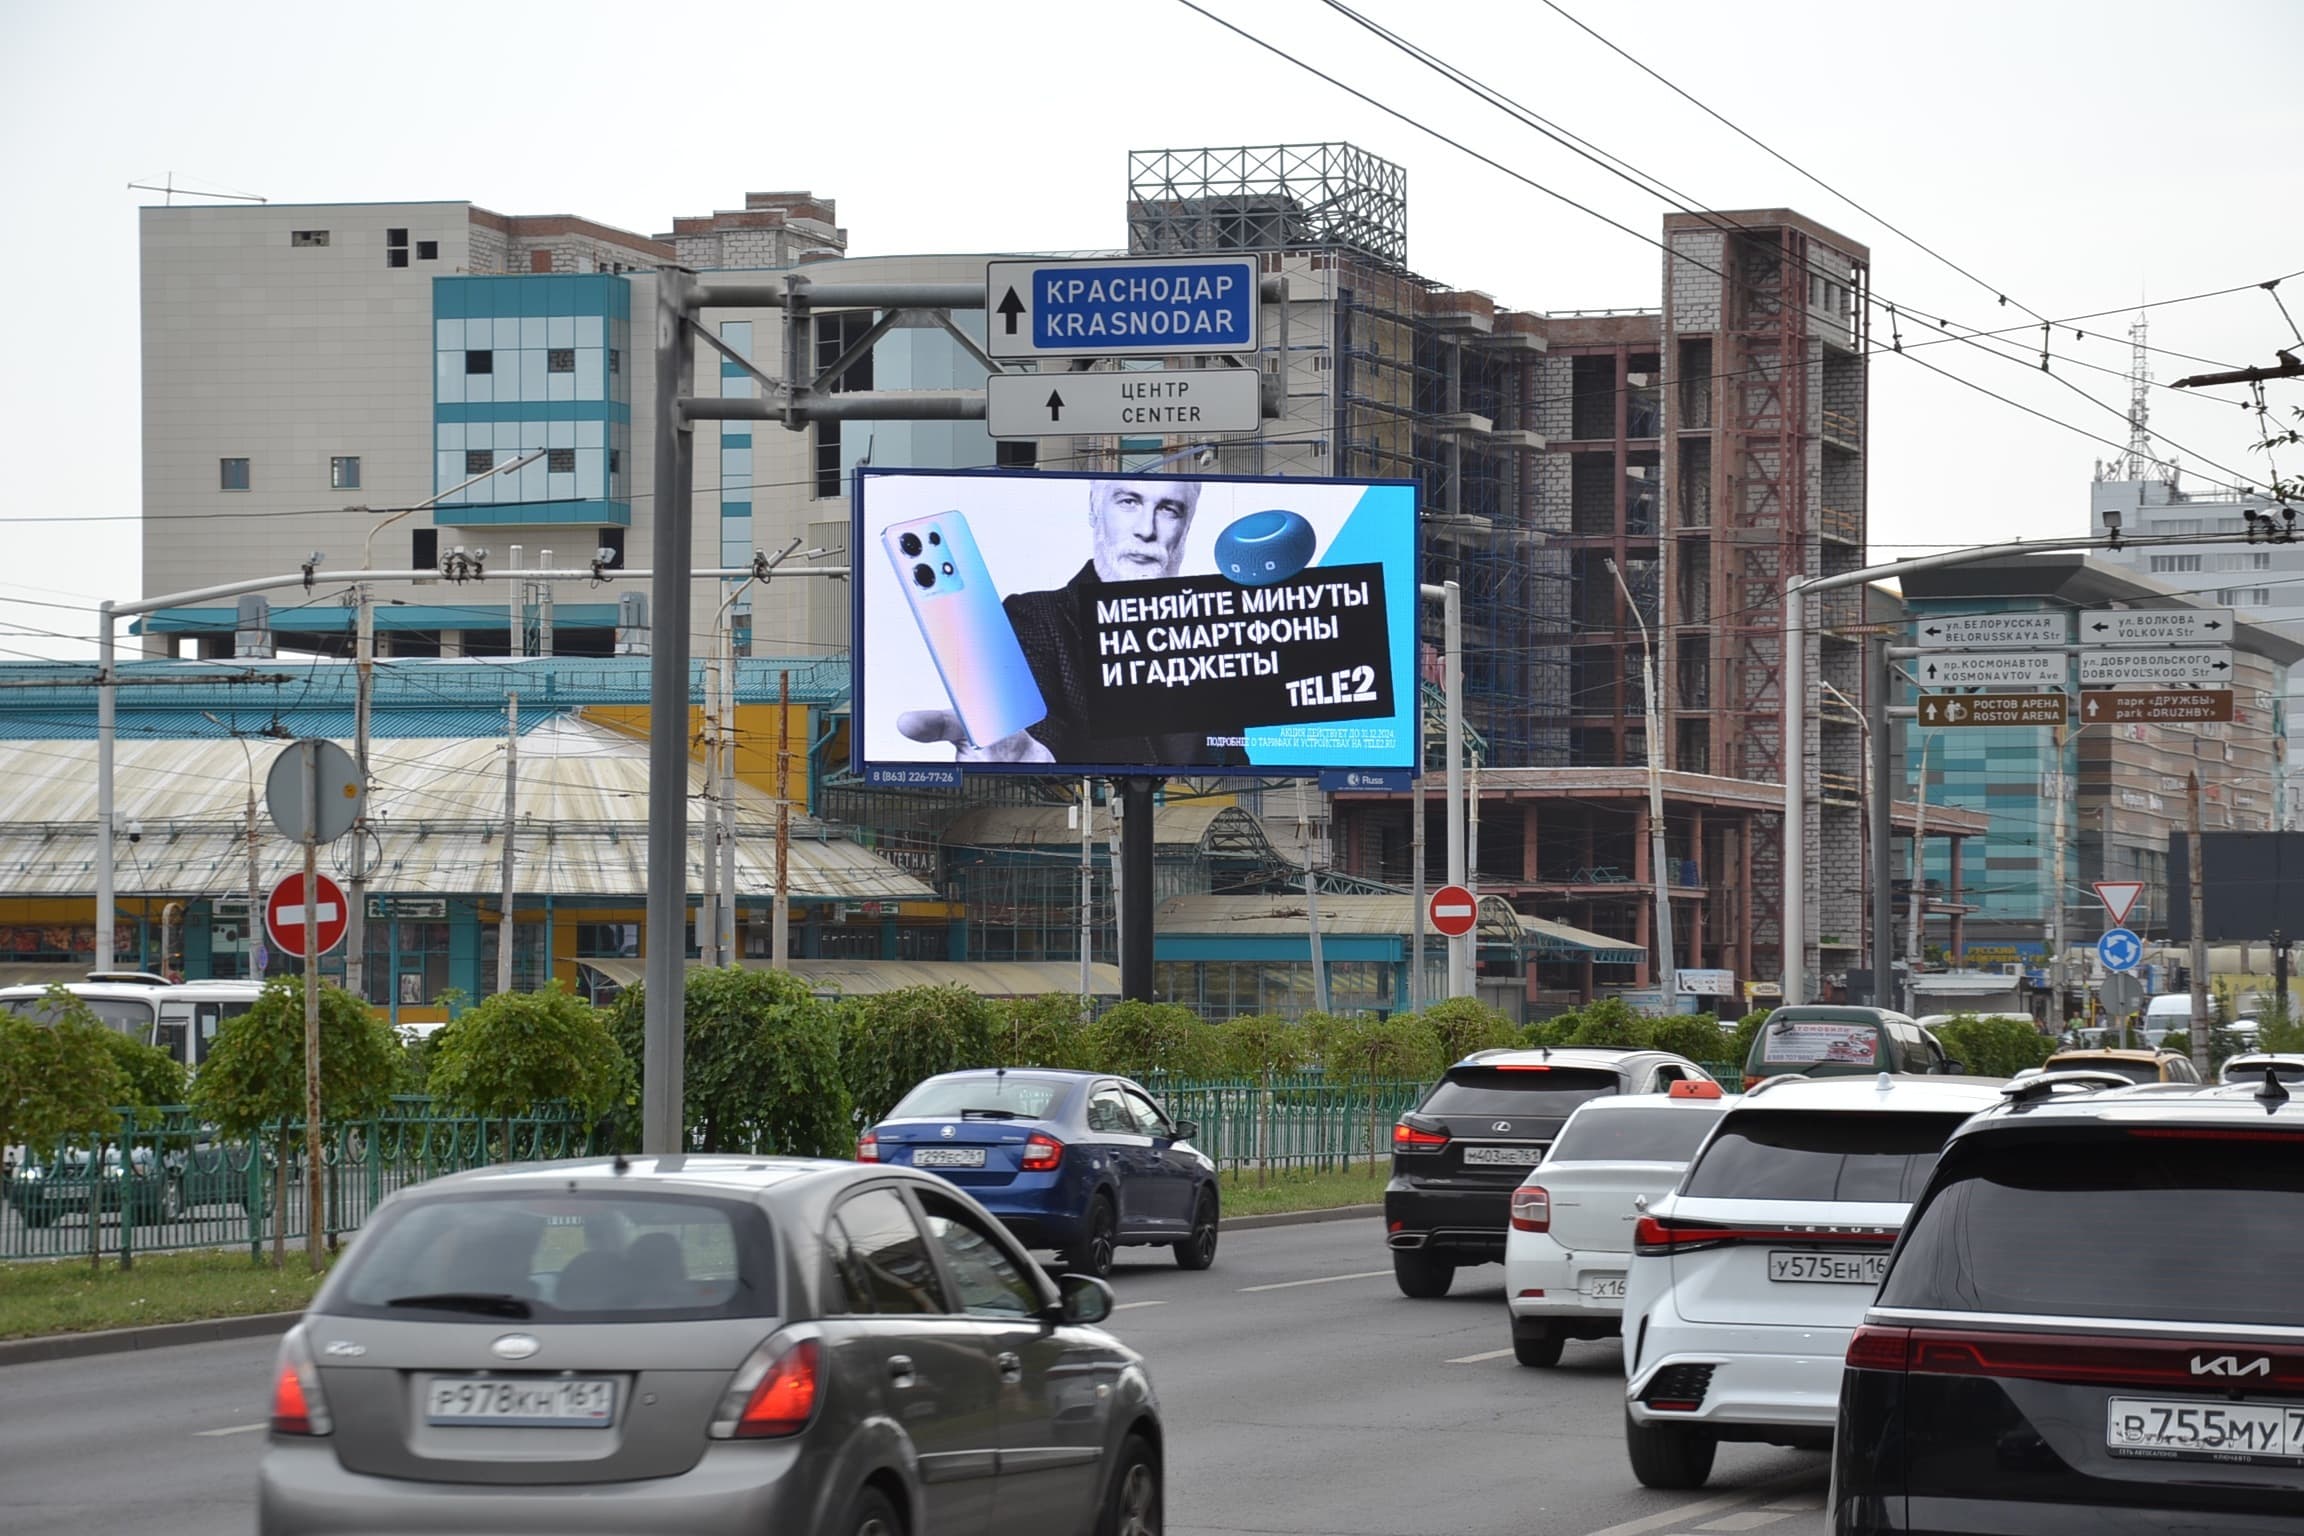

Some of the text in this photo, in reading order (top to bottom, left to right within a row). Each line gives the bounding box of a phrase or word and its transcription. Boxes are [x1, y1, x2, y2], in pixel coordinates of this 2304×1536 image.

[1047, 276, 1234, 304] КРАСНОДАР
[1047, 309, 1234, 337] KRASNODAR
[1121, 382, 1189, 400] ЦЕНТР
[1121, 406, 1201, 423] CENTER
[1096, 581, 1370, 625] МЕНЯЙТЕ МИНУТЫ
[1099, 615, 1339, 655] НА СМАРТФОНЫ
[1945, 631, 2060, 642] BELORUSSKAYA Str
[2118, 627, 2195, 638] VOLKOVA Str
[1102, 650, 1279, 688] И ГАДЖЕТЫ
[2191, 667, 2210, 677] Str
[1943, 671, 2059, 681] KOSMONAVTOV Ave
[1285, 664, 1378, 707] TELE2
[1973, 699, 2060, 709] РОСТОВ АРЕНА
[2116, 698, 2145, 707] парк
[1973, 711, 2060, 721] ROSTOV ARENA
[2116, 709, 2143, 719] park
[1280, 728, 1305, 737] АКЦИЯ
[1307, 728, 1348, 738] ДЕЙСТВУЕТ
[1206, 737, 1249, 747] ПОДРОБНЕЕ
[1259, 738, 1292, 747] ТАРИФАХ
[1301, 738, 1350, 748] УСТРОЙСТВАХ
[873, 770, 954, 783] 8 (863) 226-77-26
[1362, 776, 1384, 785] Russ
[1783, 1225, 1885, 1234] LEXUS
